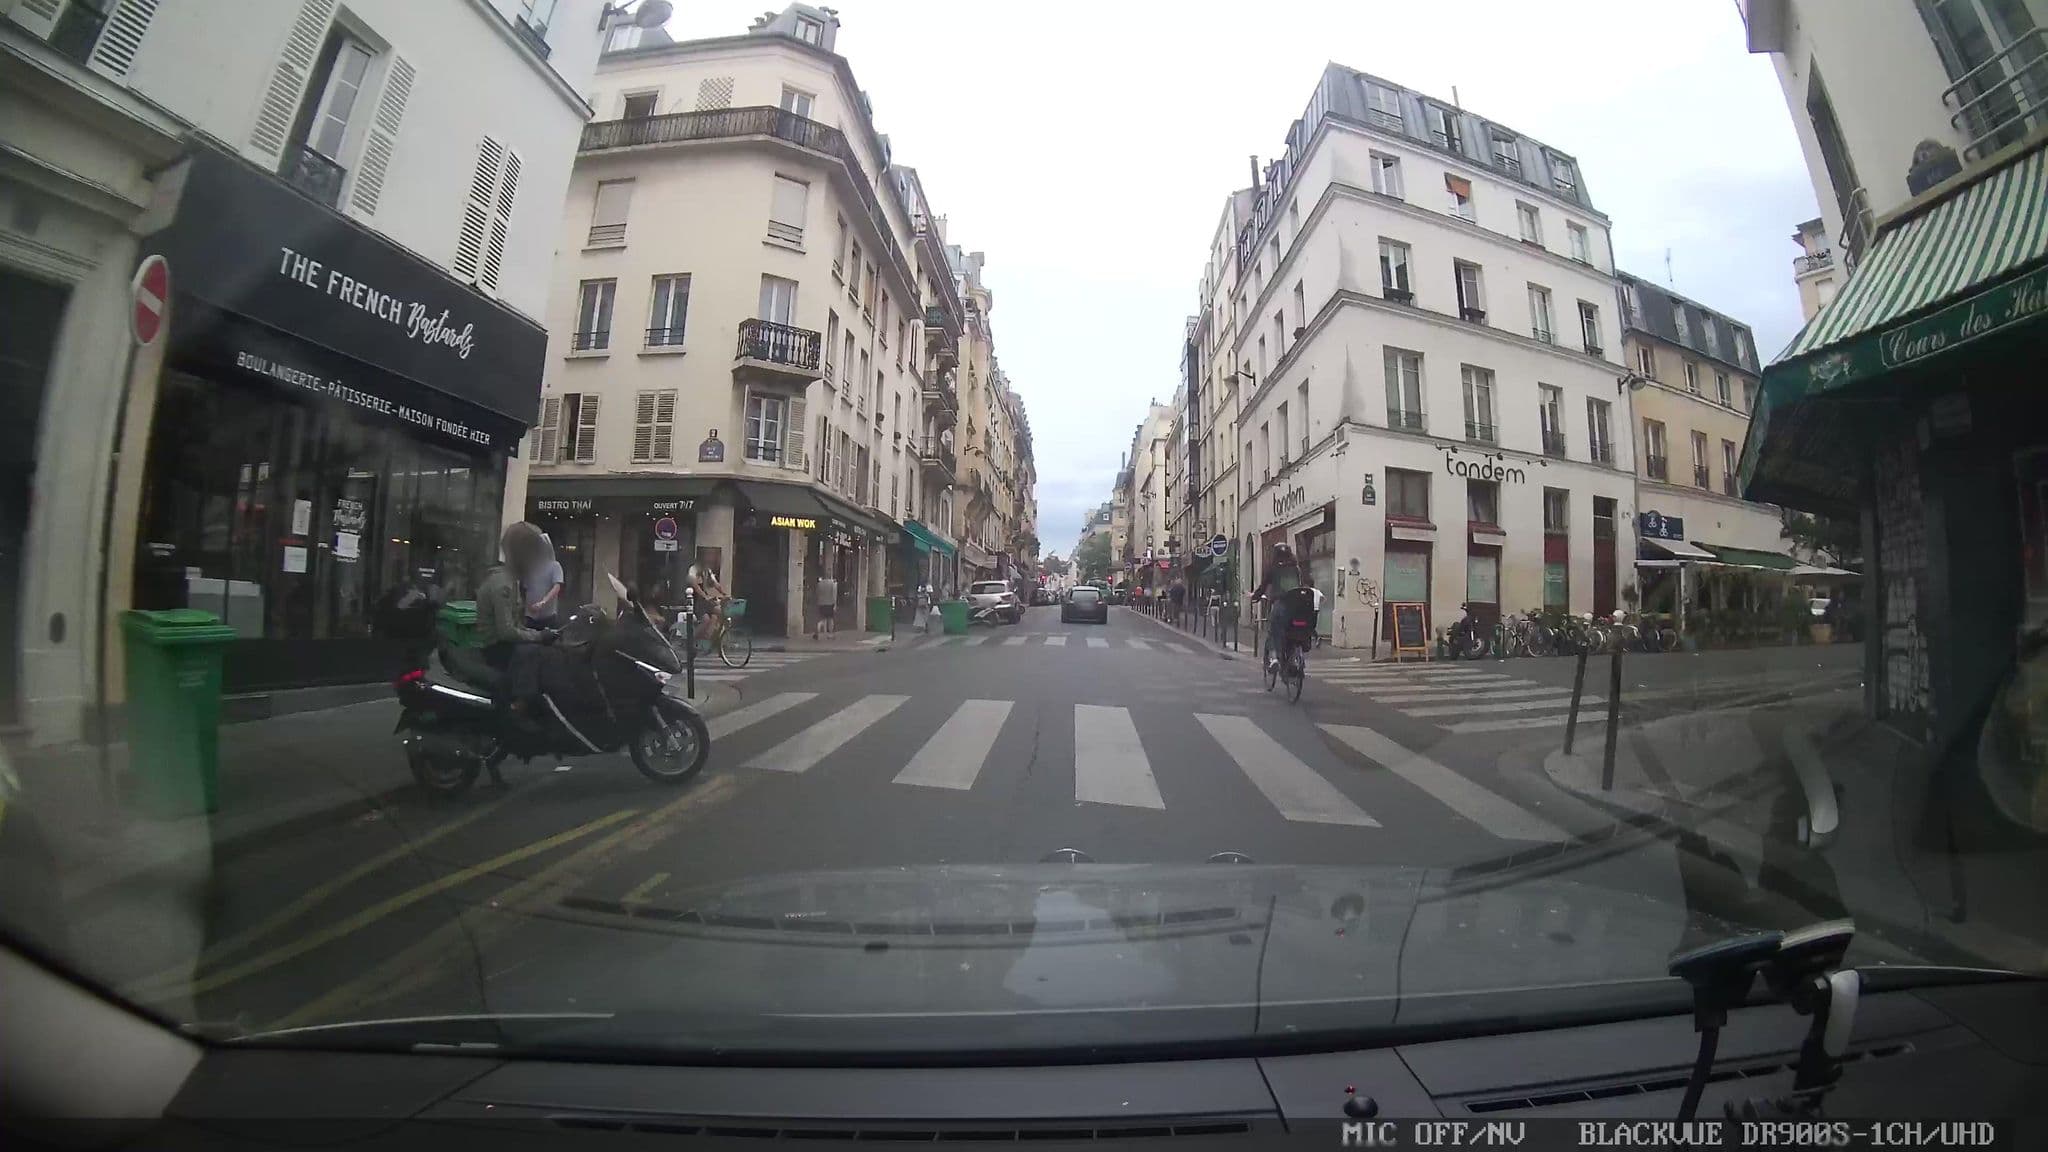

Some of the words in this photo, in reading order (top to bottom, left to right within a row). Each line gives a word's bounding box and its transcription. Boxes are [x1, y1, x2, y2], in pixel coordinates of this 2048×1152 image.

[279, 247, 322, 289] THE
[326, 270, 403, 325] FRENCH
[406, 301, 475, 359] Bastards
[1889, 329, 1946, 362] Cours
[1960, 303, 1992, 337] des
[436, 418, 469, 440] FONDÉE
[469, 429, 491, 446] HIER
[1446, 451, 1526, 484] tandem
[538, 501, 569, 510] BISTRO
[771, 516, 796, 528] ASIAN
[797, 519, 816, 529] WOK
